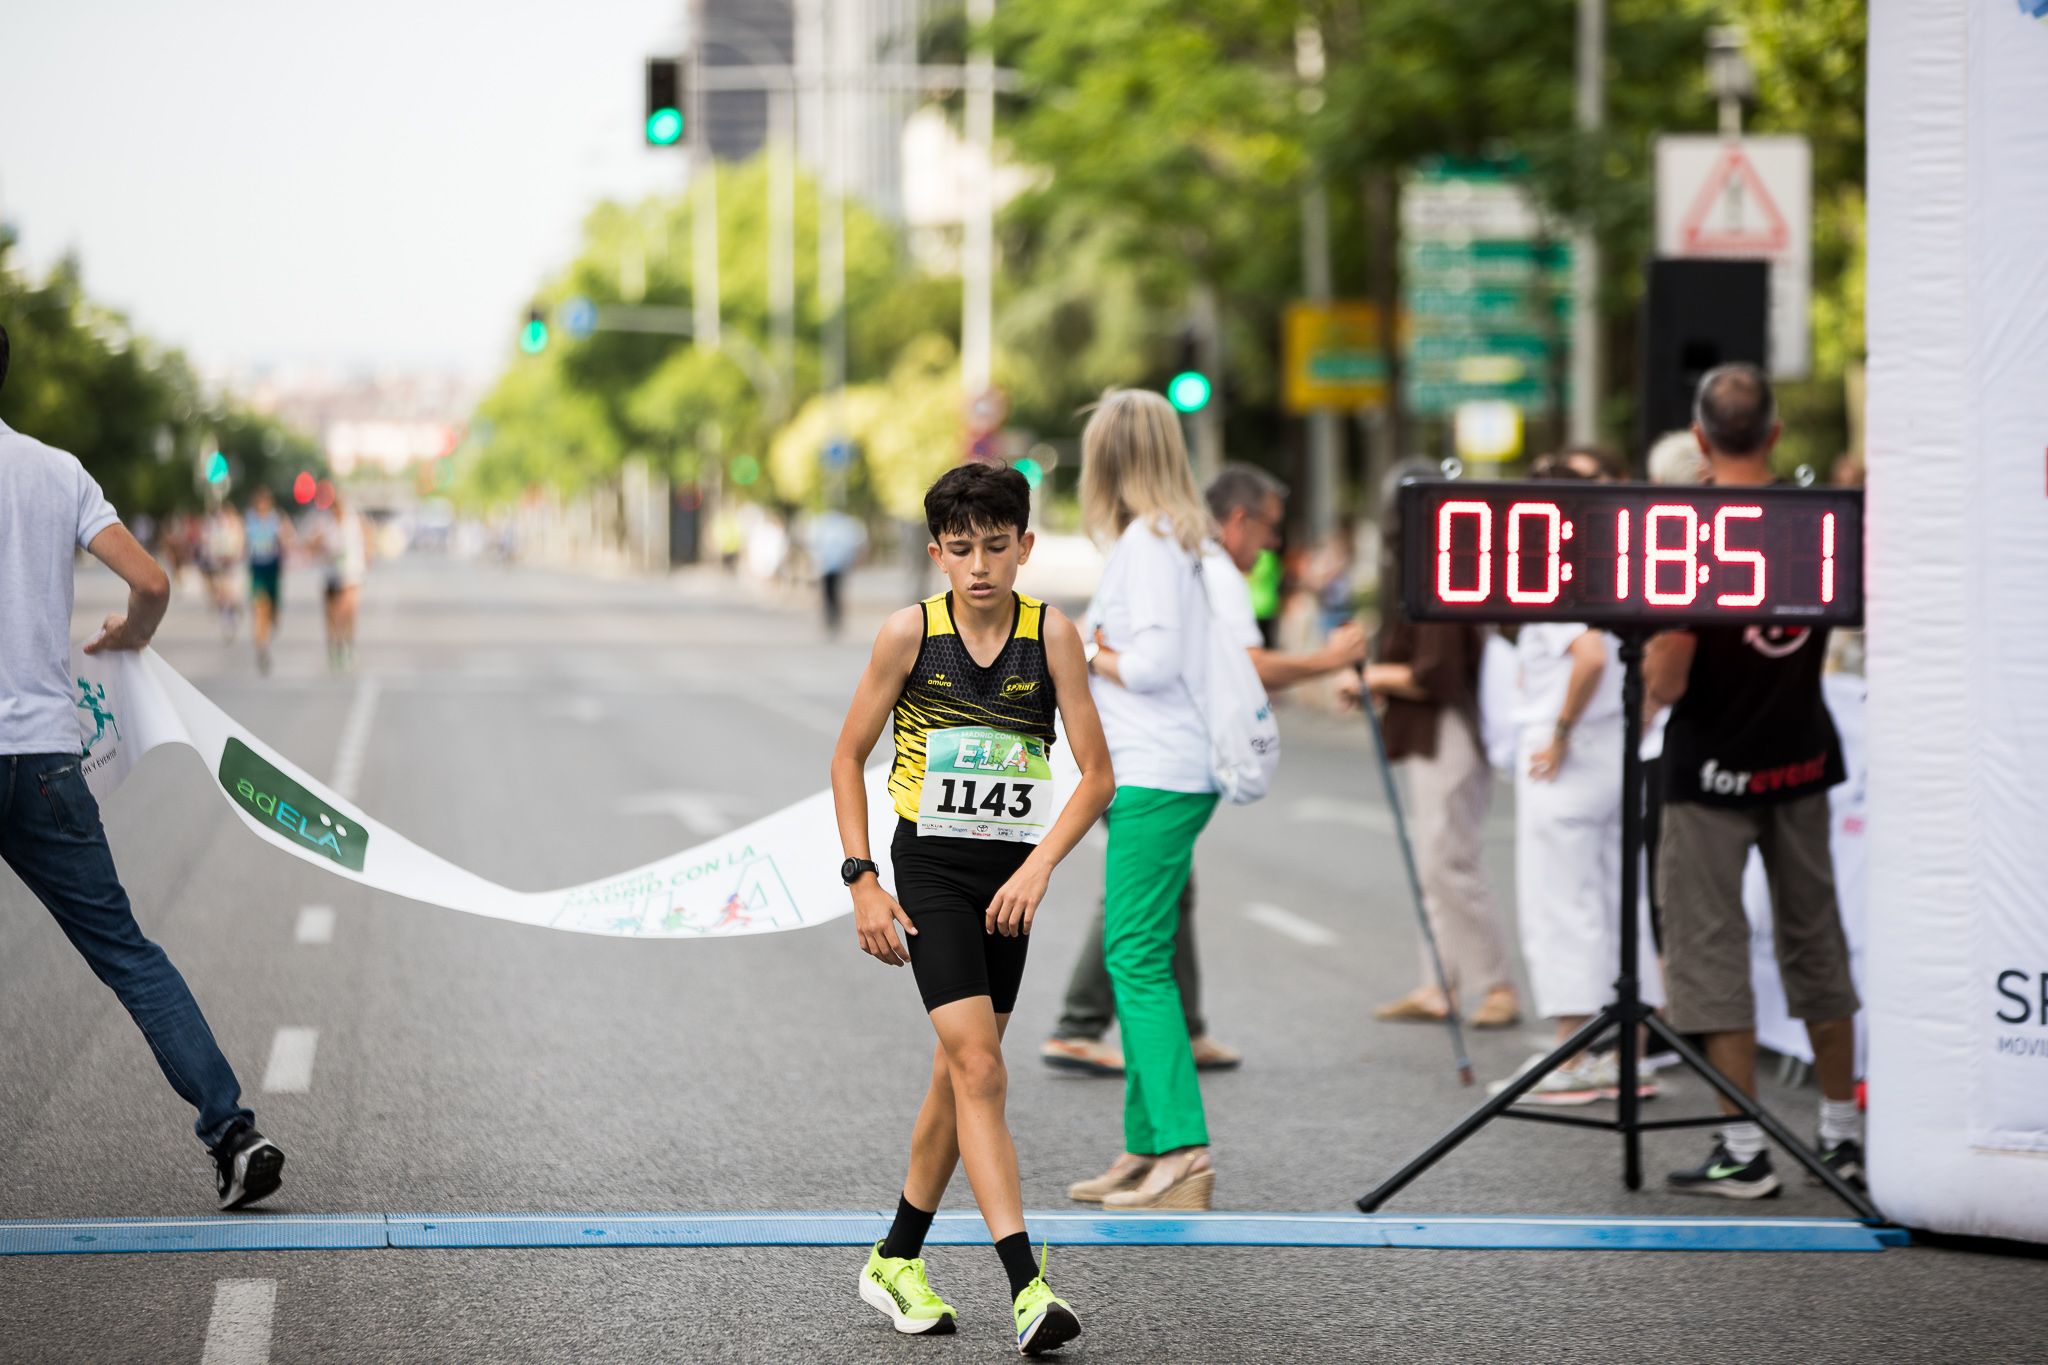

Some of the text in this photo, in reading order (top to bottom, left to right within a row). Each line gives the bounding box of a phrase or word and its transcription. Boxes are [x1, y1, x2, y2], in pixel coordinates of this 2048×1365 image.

[927, 679, 952, 688] amura
[1006, 682, 1036, 692] SPRINT
[961, 731, 993, 739] MADRID
[953, 738, 1029, 773] ELA
[937, 778, 1035, 819] 1143
[236, 777, 343, 857] adELA
[671, 858, 722, 888] CON
[728, 844, 757, 866] LA
